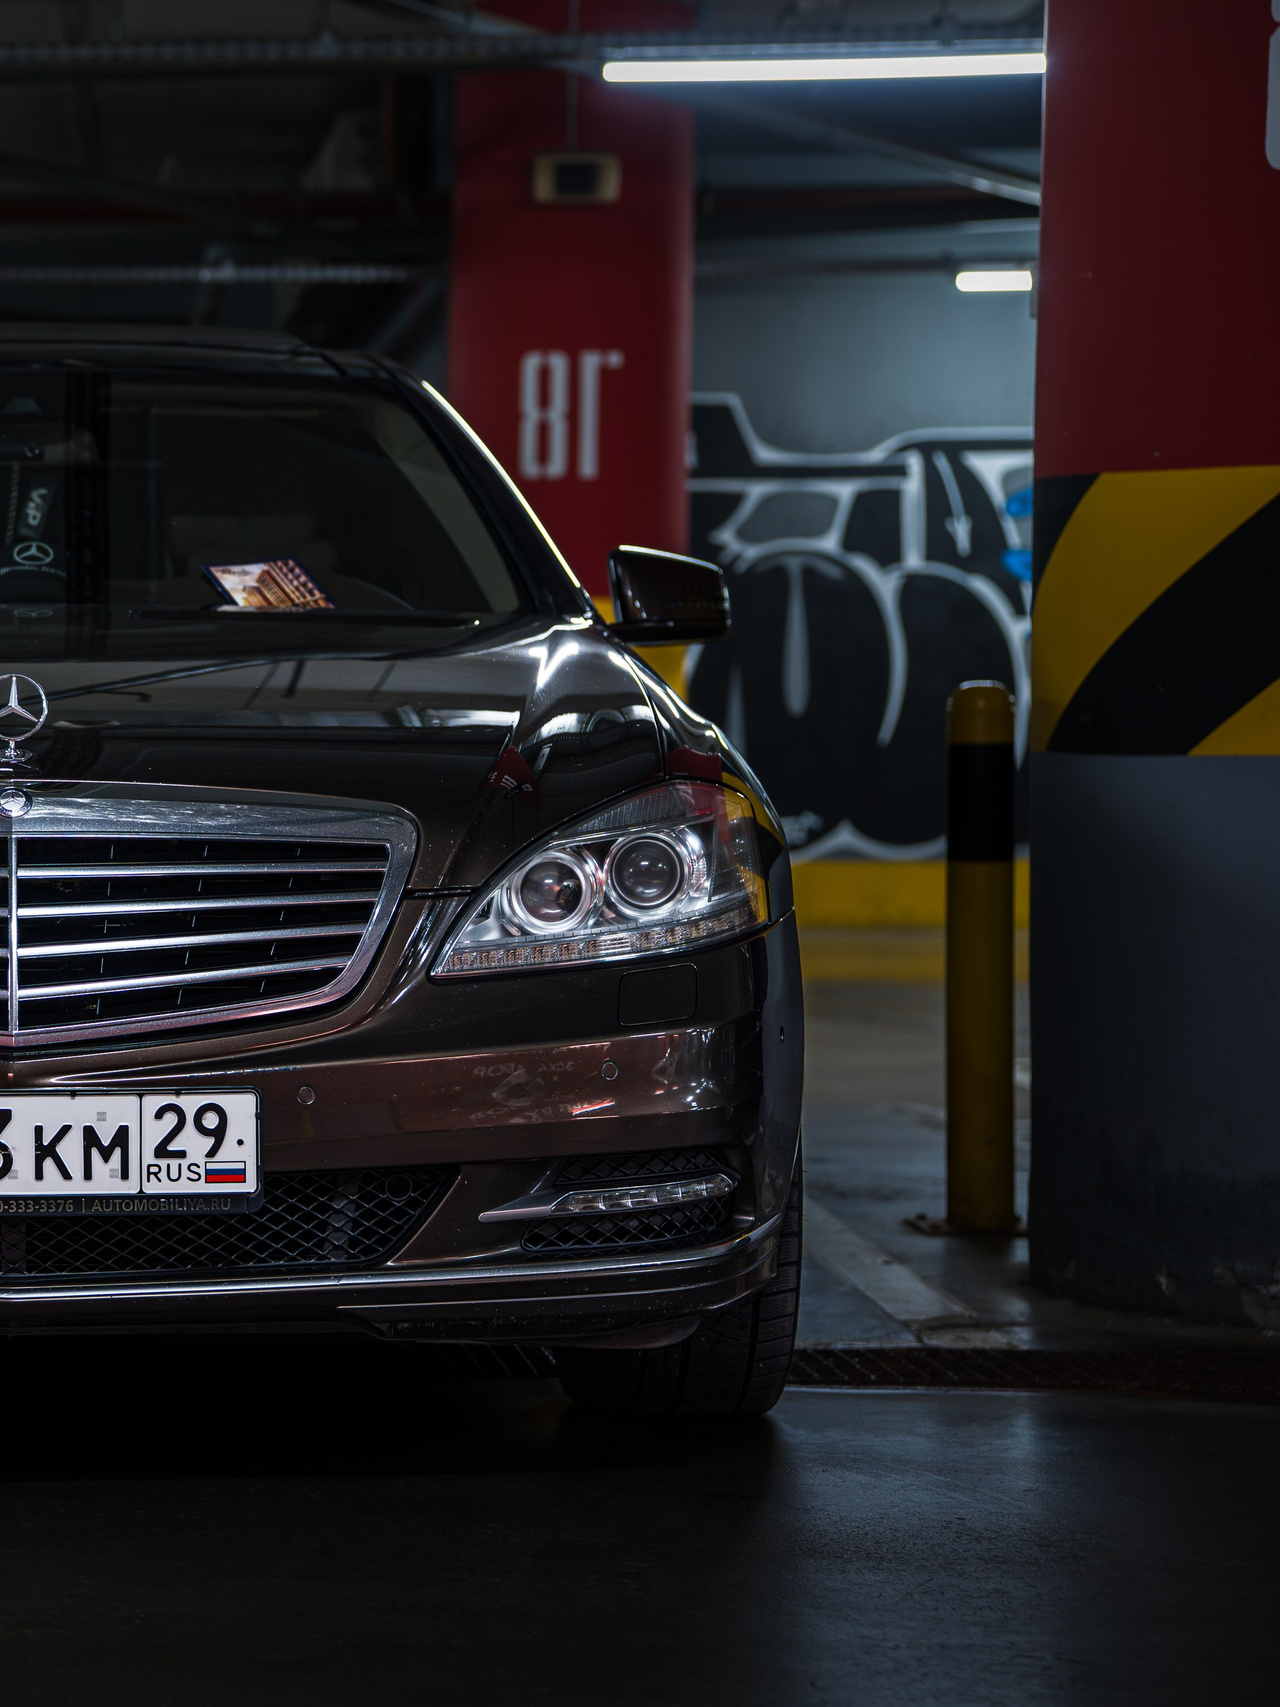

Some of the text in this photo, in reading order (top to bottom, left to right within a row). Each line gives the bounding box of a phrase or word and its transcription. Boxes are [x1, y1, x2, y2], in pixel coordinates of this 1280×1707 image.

[153, 1102, 229, 1158] 29
[146, 1162, 202, 1183] RUS
[91, 1198, 232, 1213] AUTOMOBILIYA.RU
